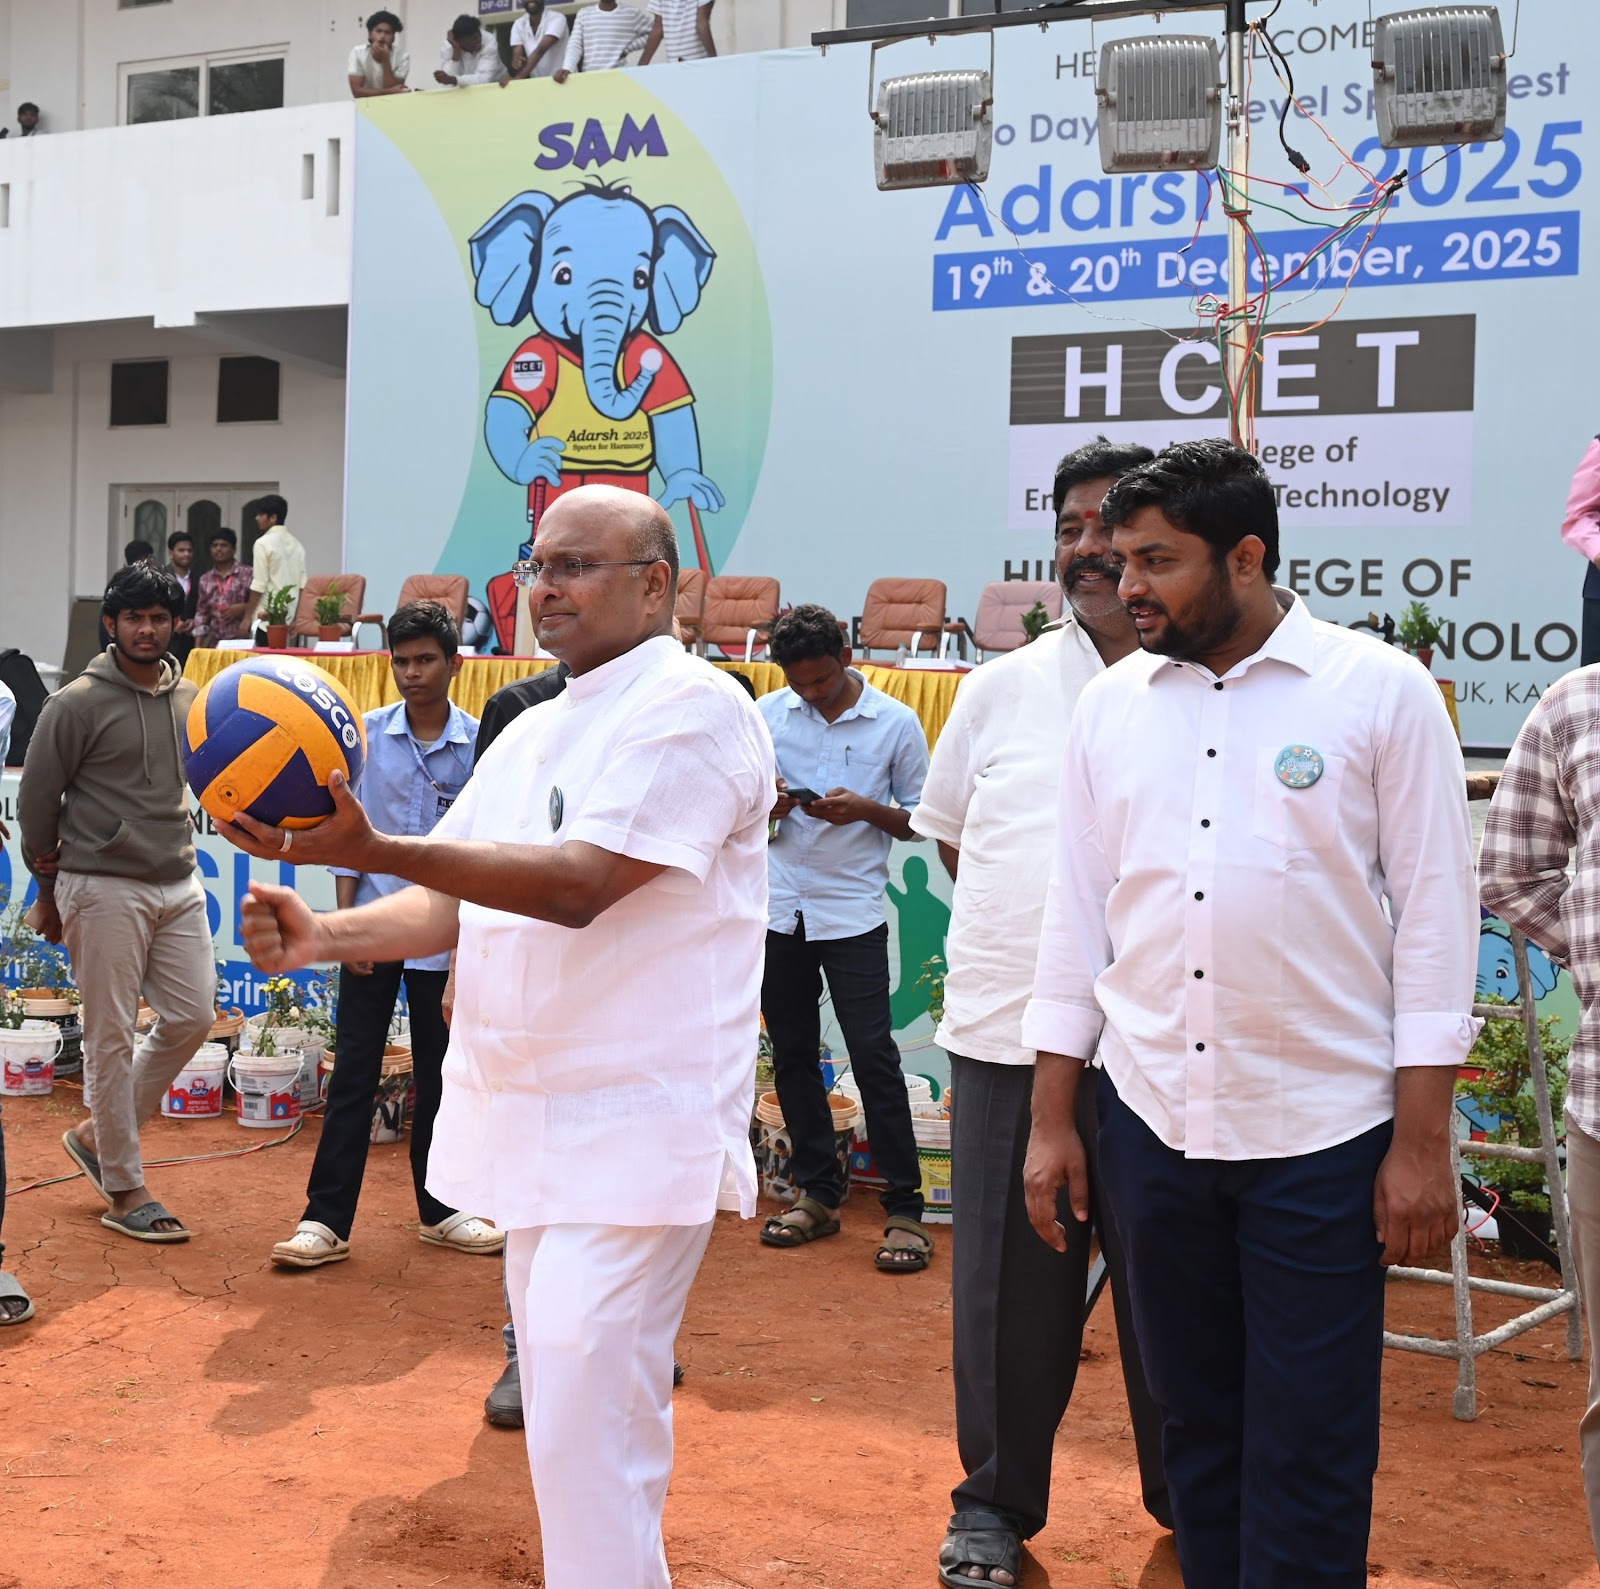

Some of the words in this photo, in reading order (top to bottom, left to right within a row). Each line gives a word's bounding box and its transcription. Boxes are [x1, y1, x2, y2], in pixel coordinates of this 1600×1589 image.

[1245, 85, 1329, 123] evel
[1507, 63, 1570, 99] est
[534, 112, 669, 171] SAM
[1348, 121, 1583, 211] 2025
[948, 254, 1013, 300] 19th
[1026, 261, 1055, 297] &
[1069, 248, 1142, 294] 20th
[1442, 226, 1562, 272] 2025
[514, 362, 542, 372] HCET
[567, 429, 618, 442] Adarsh
[623, 431, 649, 441] 2025
[572, 443, 596, 452] Sports
[598, 443, 609, 451] for
[610, 442, 645, 451] Harmony
[1326, 436, 1359, 463] of
[1272, 480, 1451, 513] Technology
[1402, 558, 1472, 598] OF
[275, 665, 358, 749] COSCO
